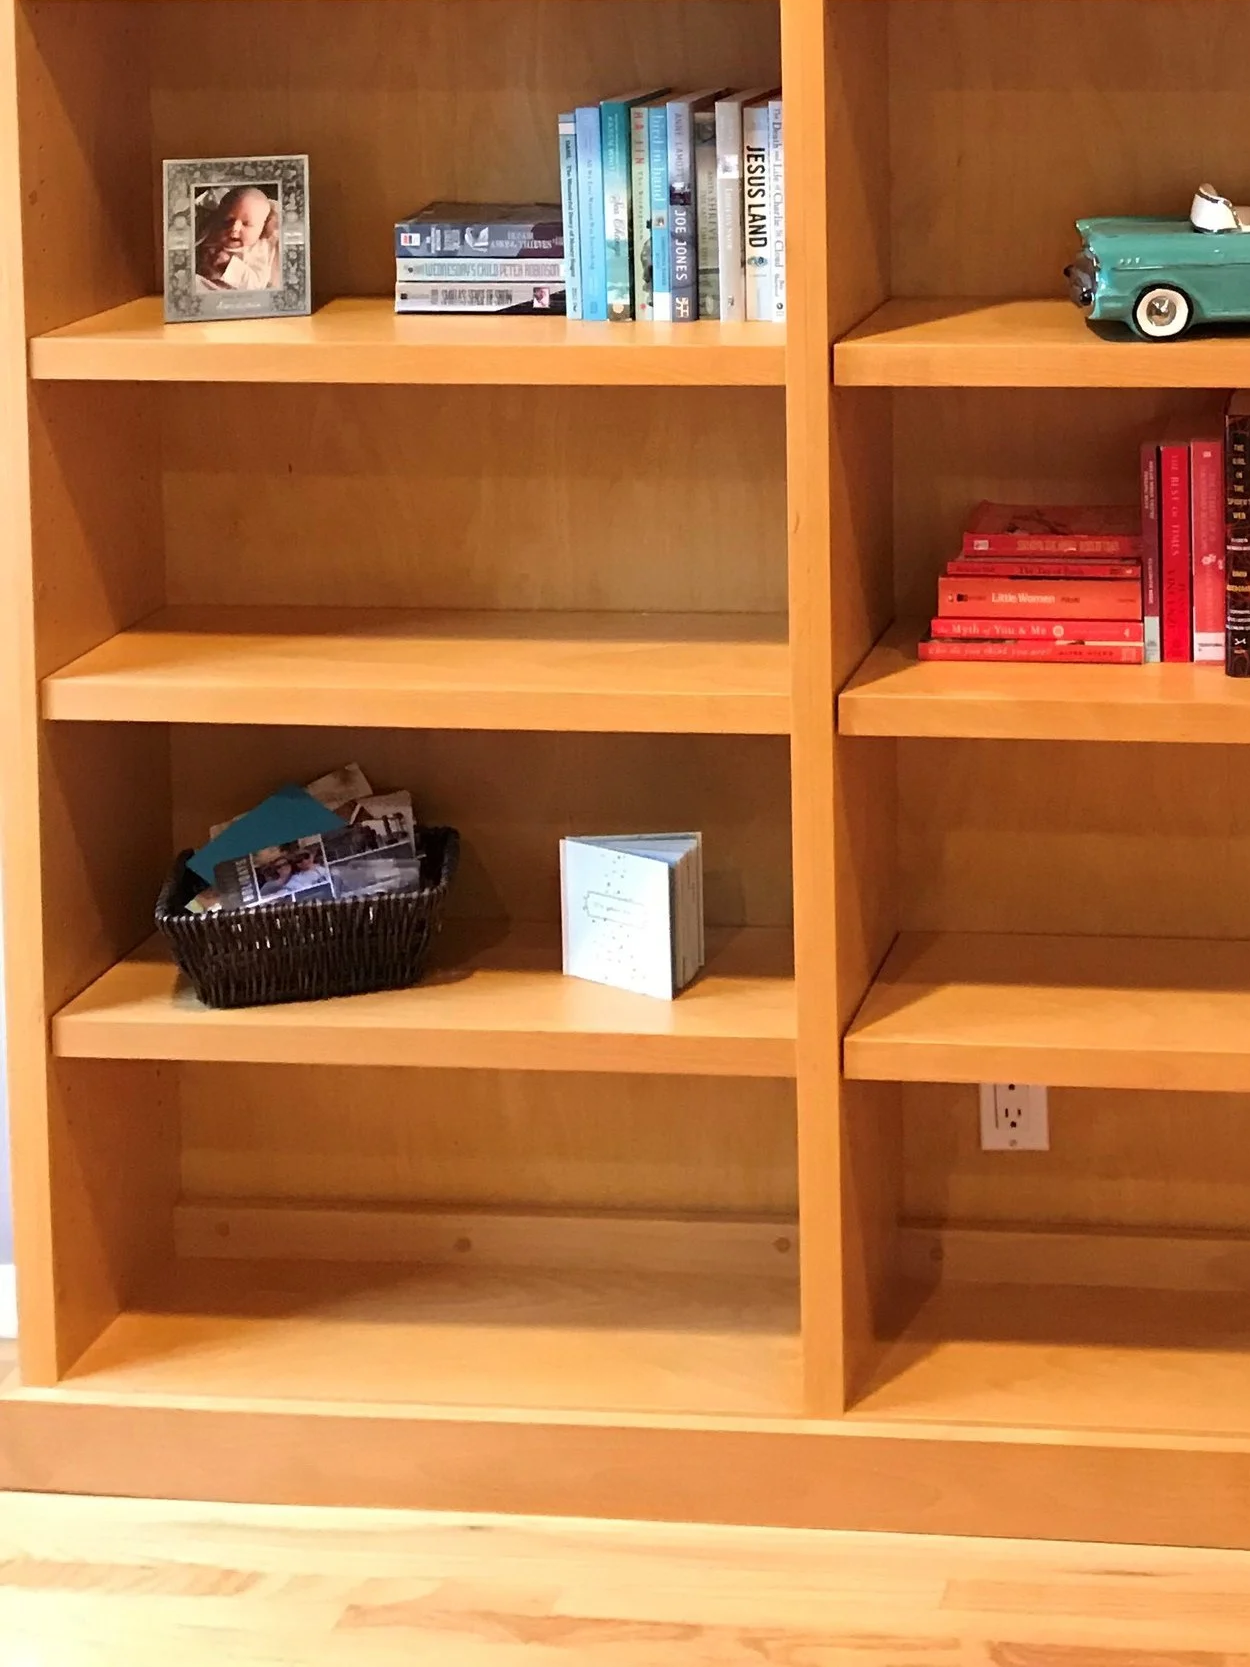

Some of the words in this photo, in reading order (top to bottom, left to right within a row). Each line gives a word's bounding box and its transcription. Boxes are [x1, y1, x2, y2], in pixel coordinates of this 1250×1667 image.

[651, 114, 664, 145] bird
[652, 149, 664, 162] in
[653, 167, 666, 202] hand
[746, 145, 767, 199] JESUS
[674, 210, 687, 234] JOE
[748, 203, 768, 248] LAND
[676, 239, 688, 281] JONES
[992, 592, 1017, 604] Little
[1018, 593, 1056, 604] Women
[952, 623, 980, 634] Myth
[994, 624, 1016, 635] You
